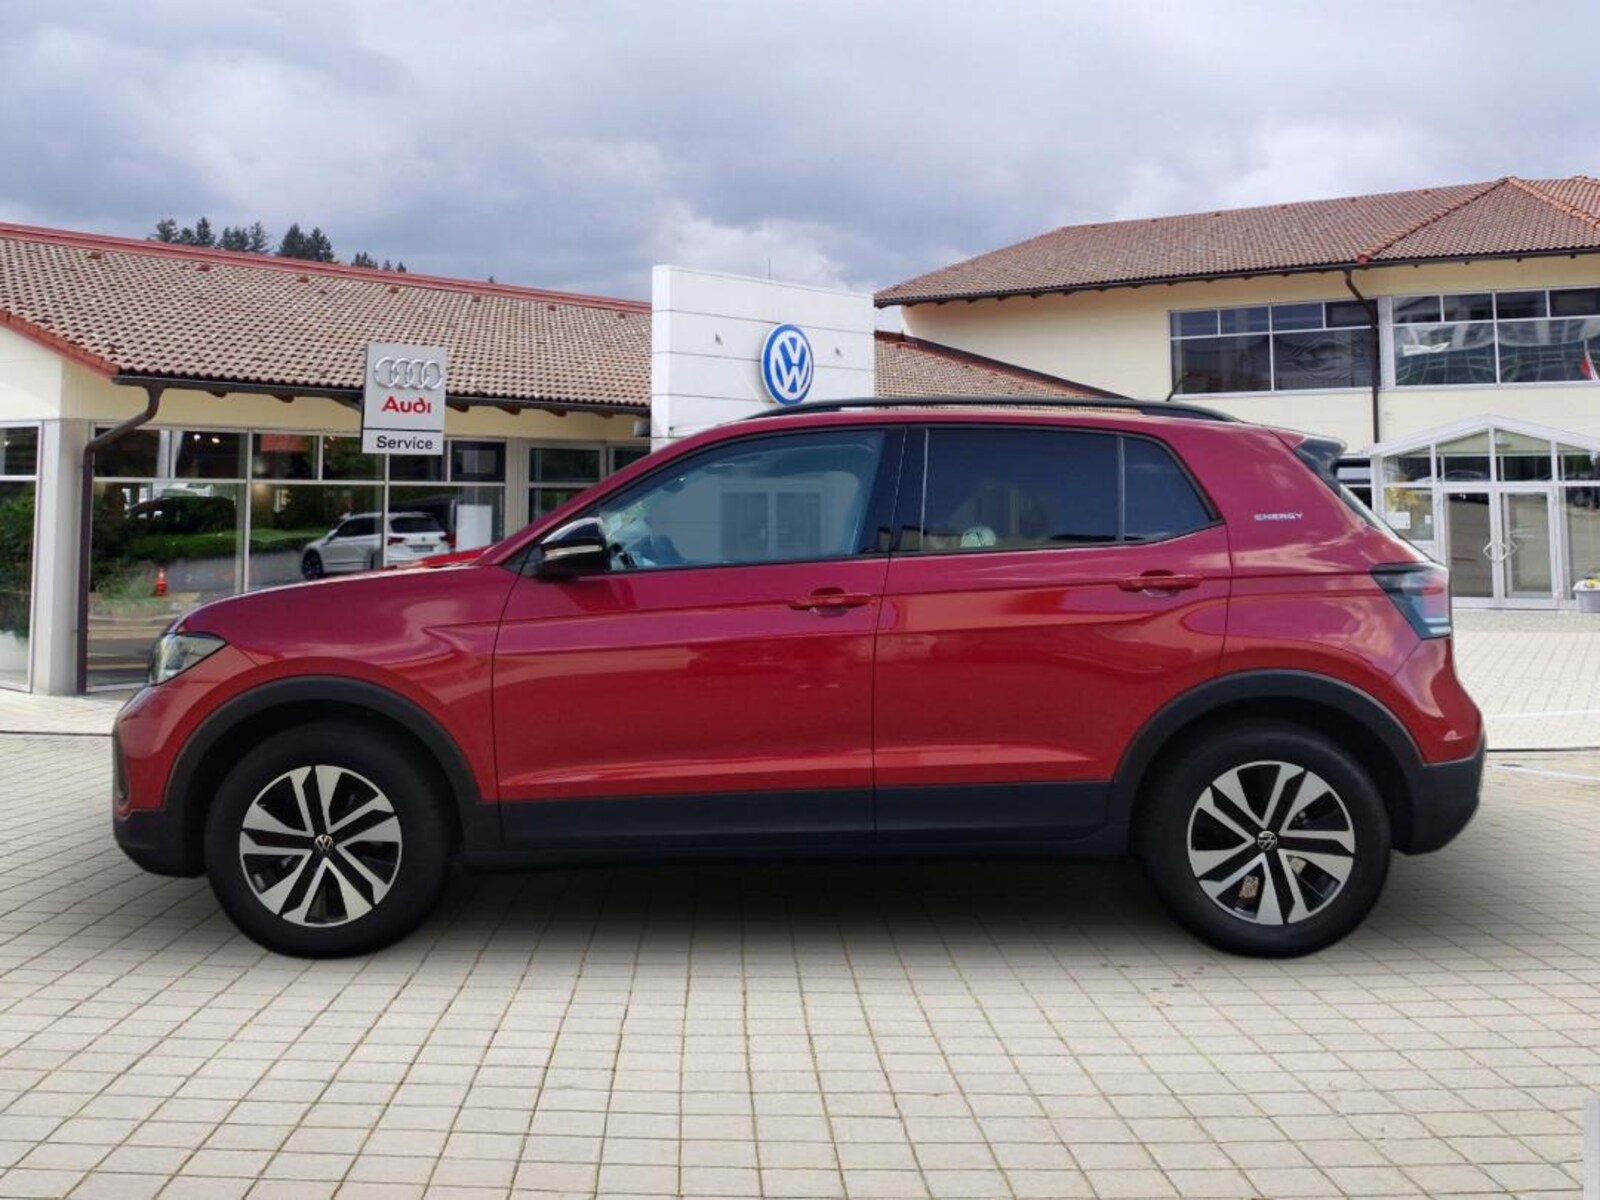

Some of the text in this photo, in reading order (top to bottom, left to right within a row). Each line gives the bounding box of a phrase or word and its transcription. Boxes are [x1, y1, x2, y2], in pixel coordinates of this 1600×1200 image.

[763, 325, 813, 404] VW
[381, 395, 432, 414] Audi
[376, 435, 433, 450] Service
